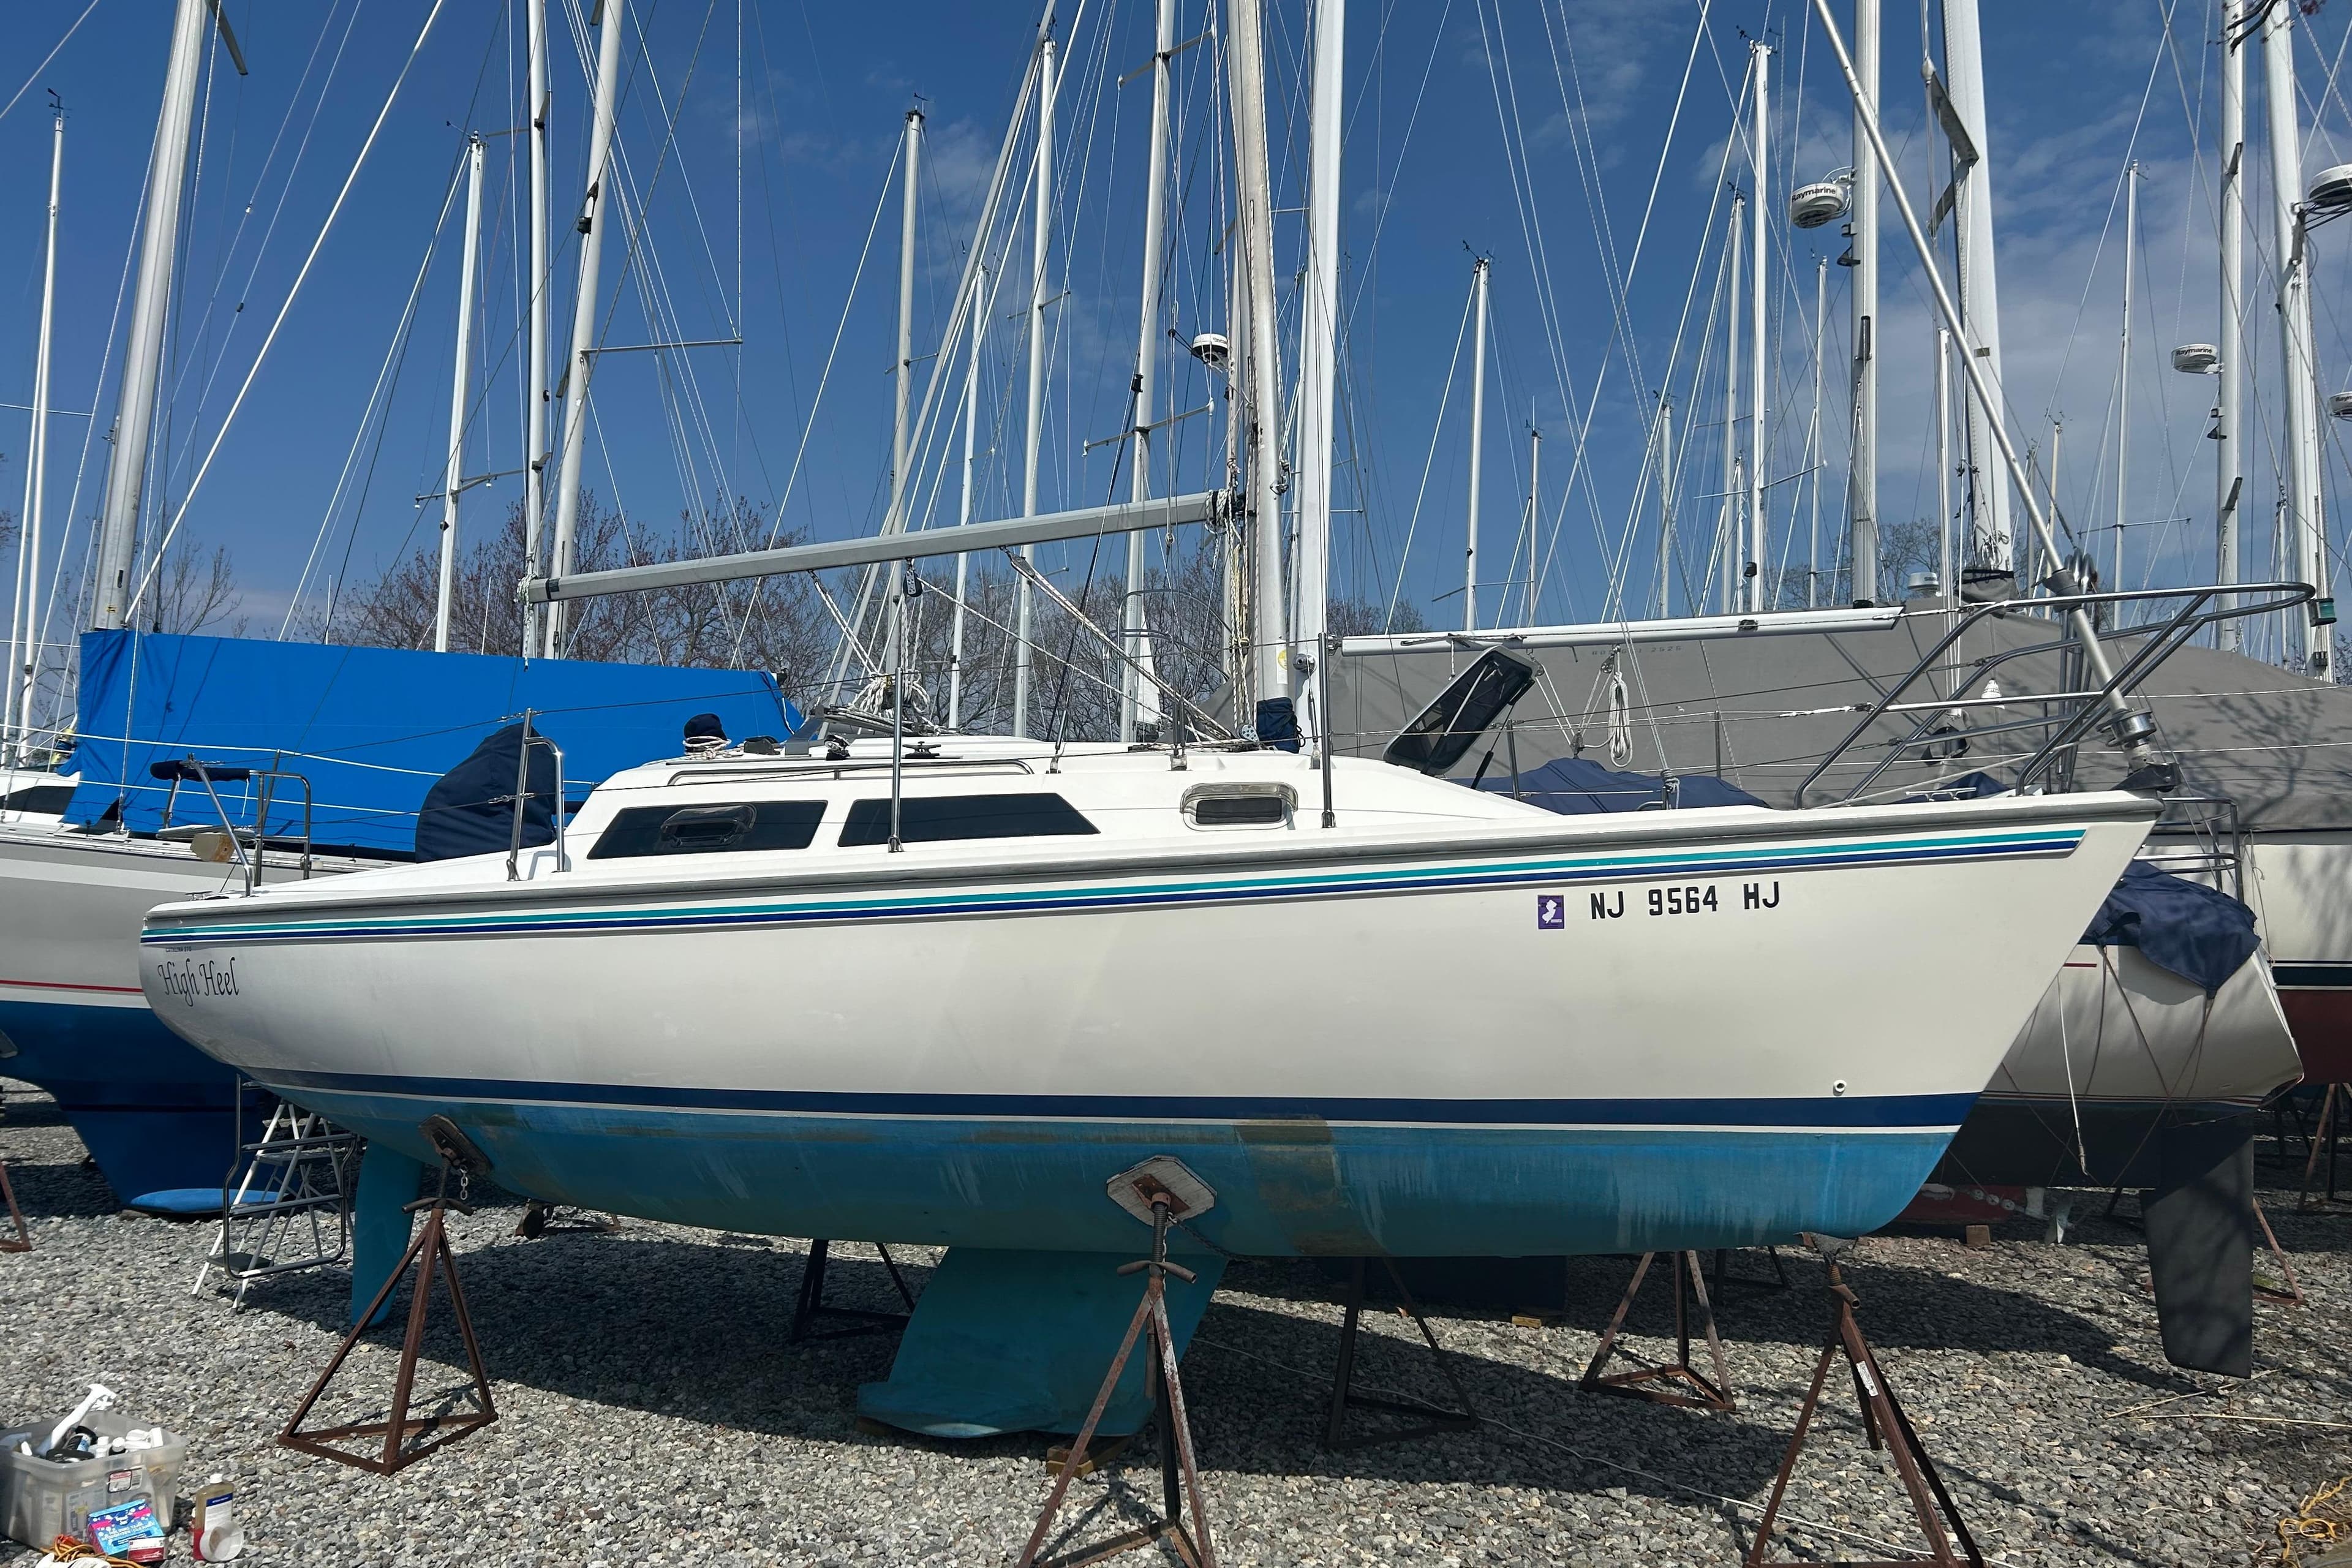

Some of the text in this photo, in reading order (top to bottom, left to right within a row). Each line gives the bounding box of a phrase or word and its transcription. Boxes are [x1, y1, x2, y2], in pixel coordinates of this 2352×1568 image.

[1792, 186, 1836, 203] Raymarine
[1591, 881, 1779, 919] NJ 9564 HJ
[157, 957, 239, 1007] High Heel
